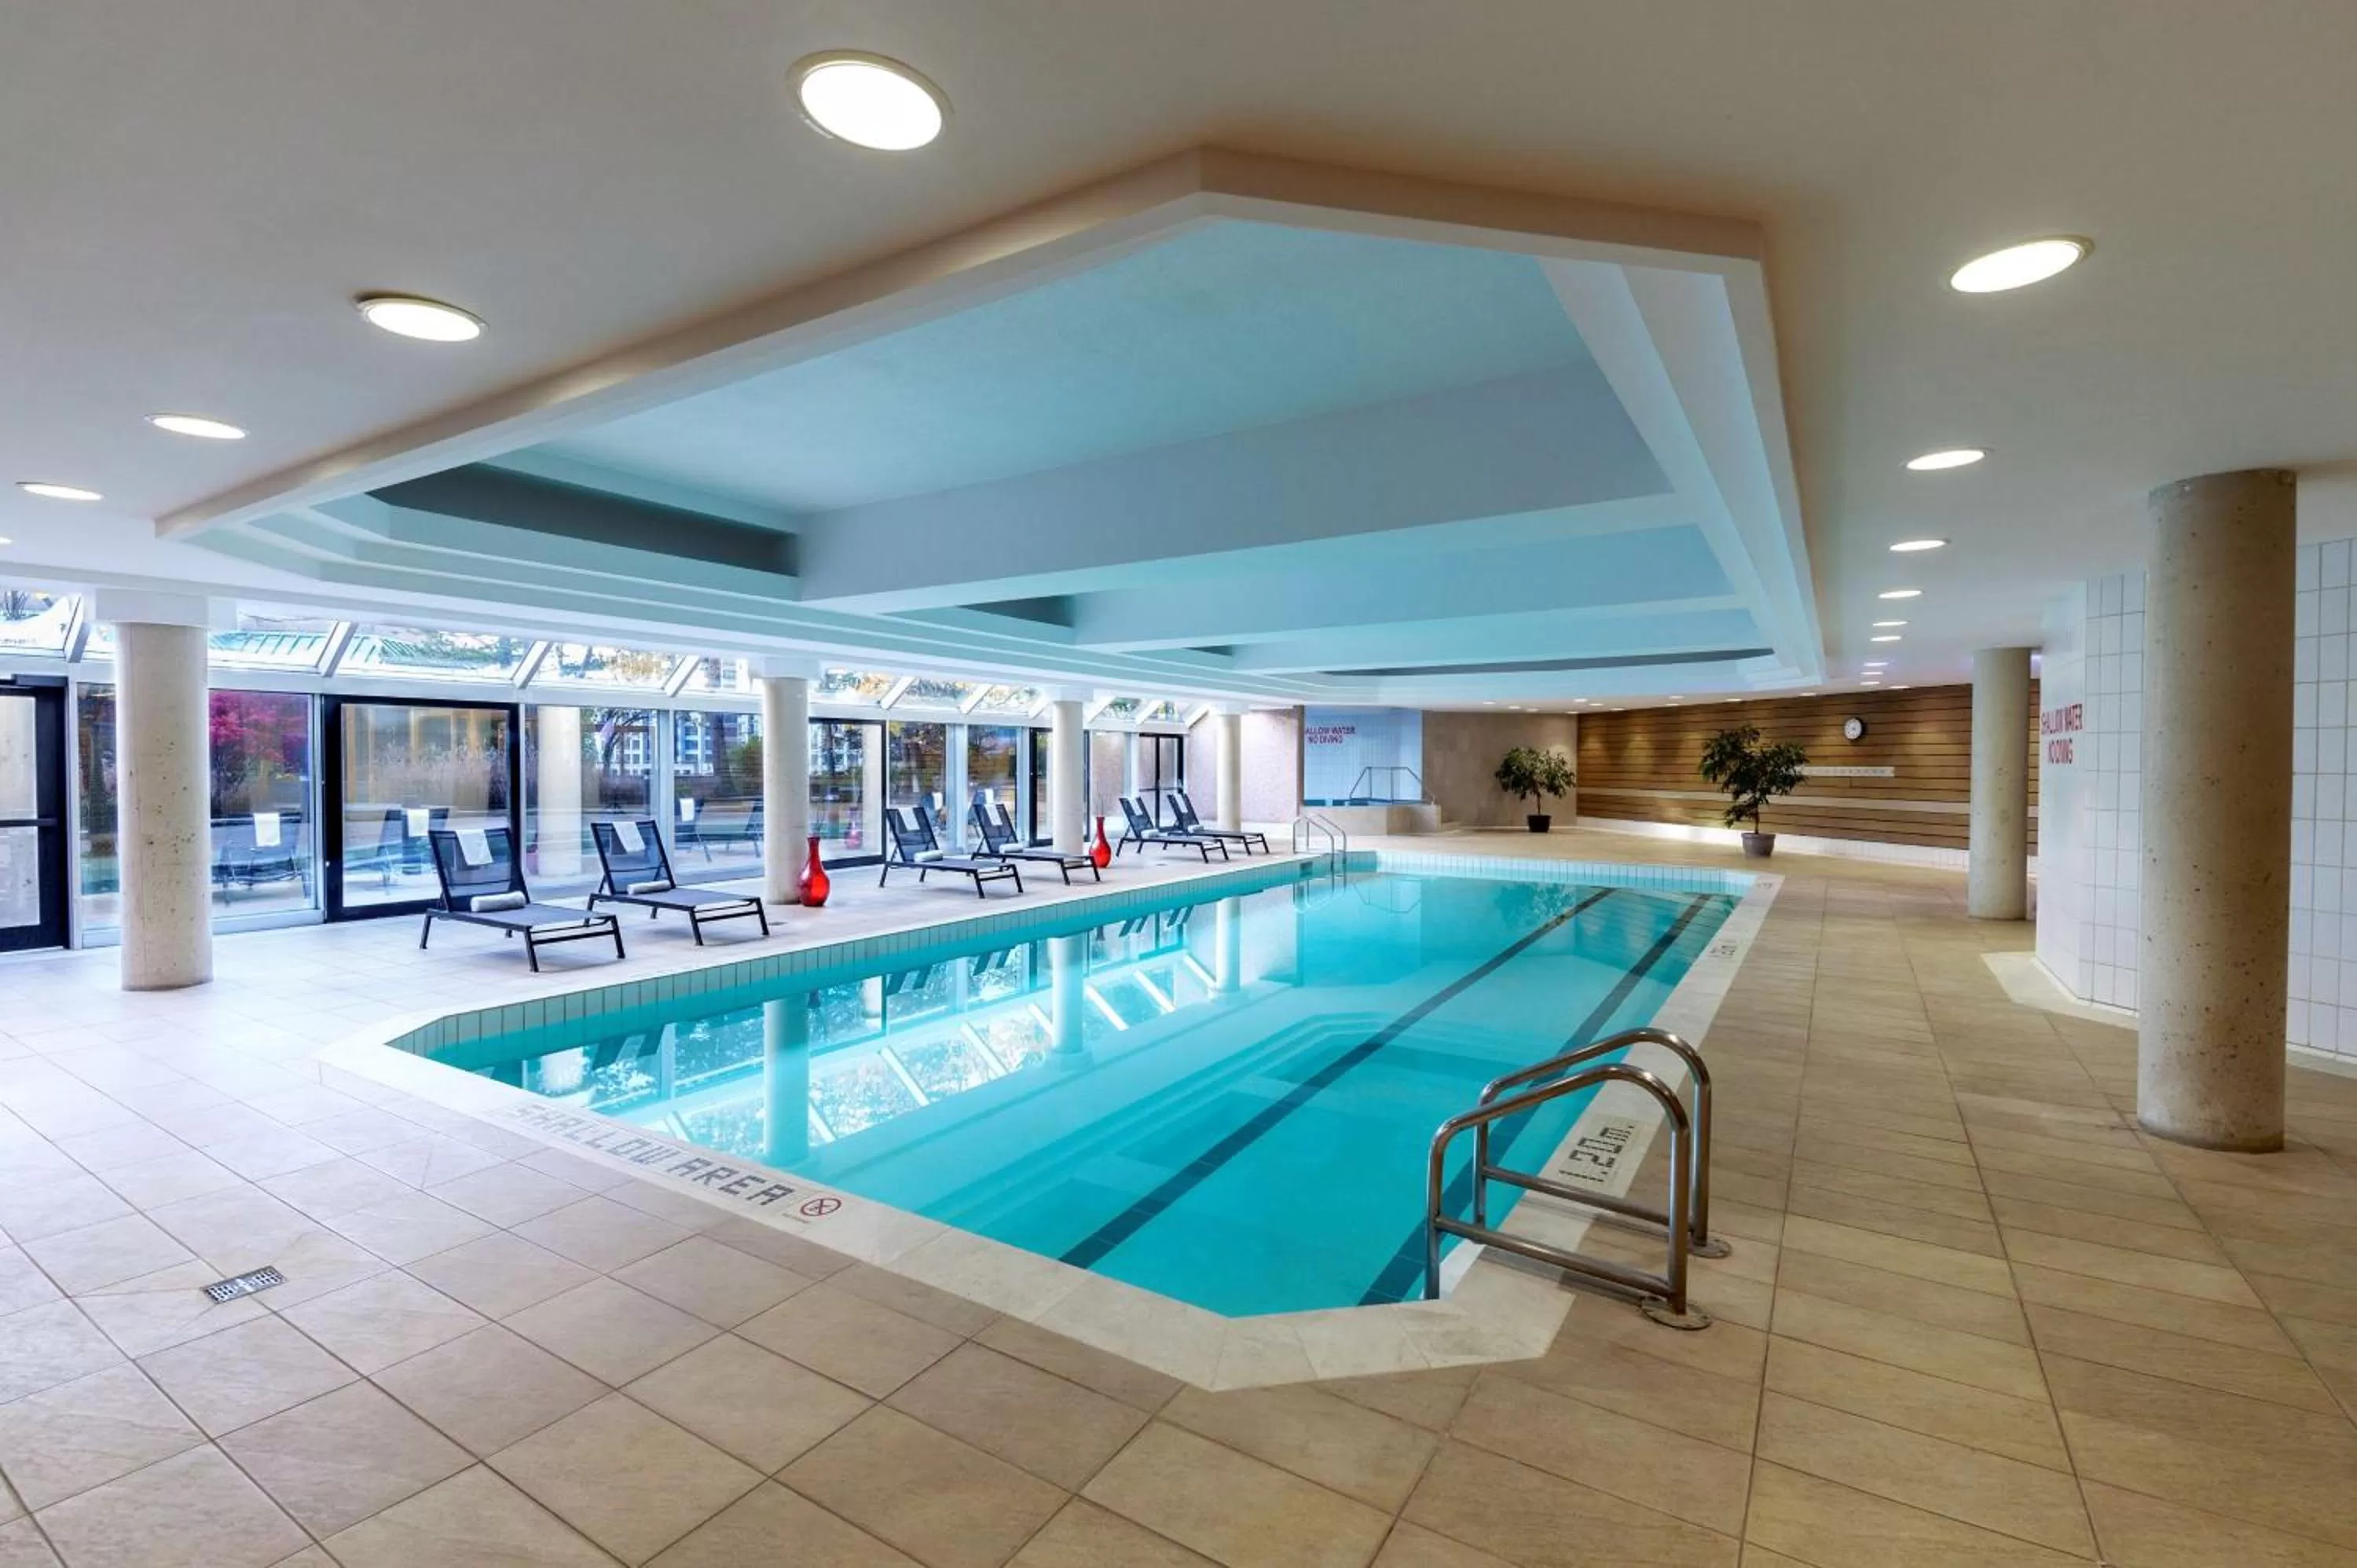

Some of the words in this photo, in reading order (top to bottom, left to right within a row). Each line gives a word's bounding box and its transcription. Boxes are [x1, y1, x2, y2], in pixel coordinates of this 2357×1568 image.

[2065, 704, 2083, 732] WATER
[1308, 735, 1318, 744] NO
[1320, 735, 1343, 744] DIVING
[1332, 726, 1355, 735] WATER
[516, 1103, 681, 1164] SHALLOW
[665, 1157, 796, 1205] AREA
